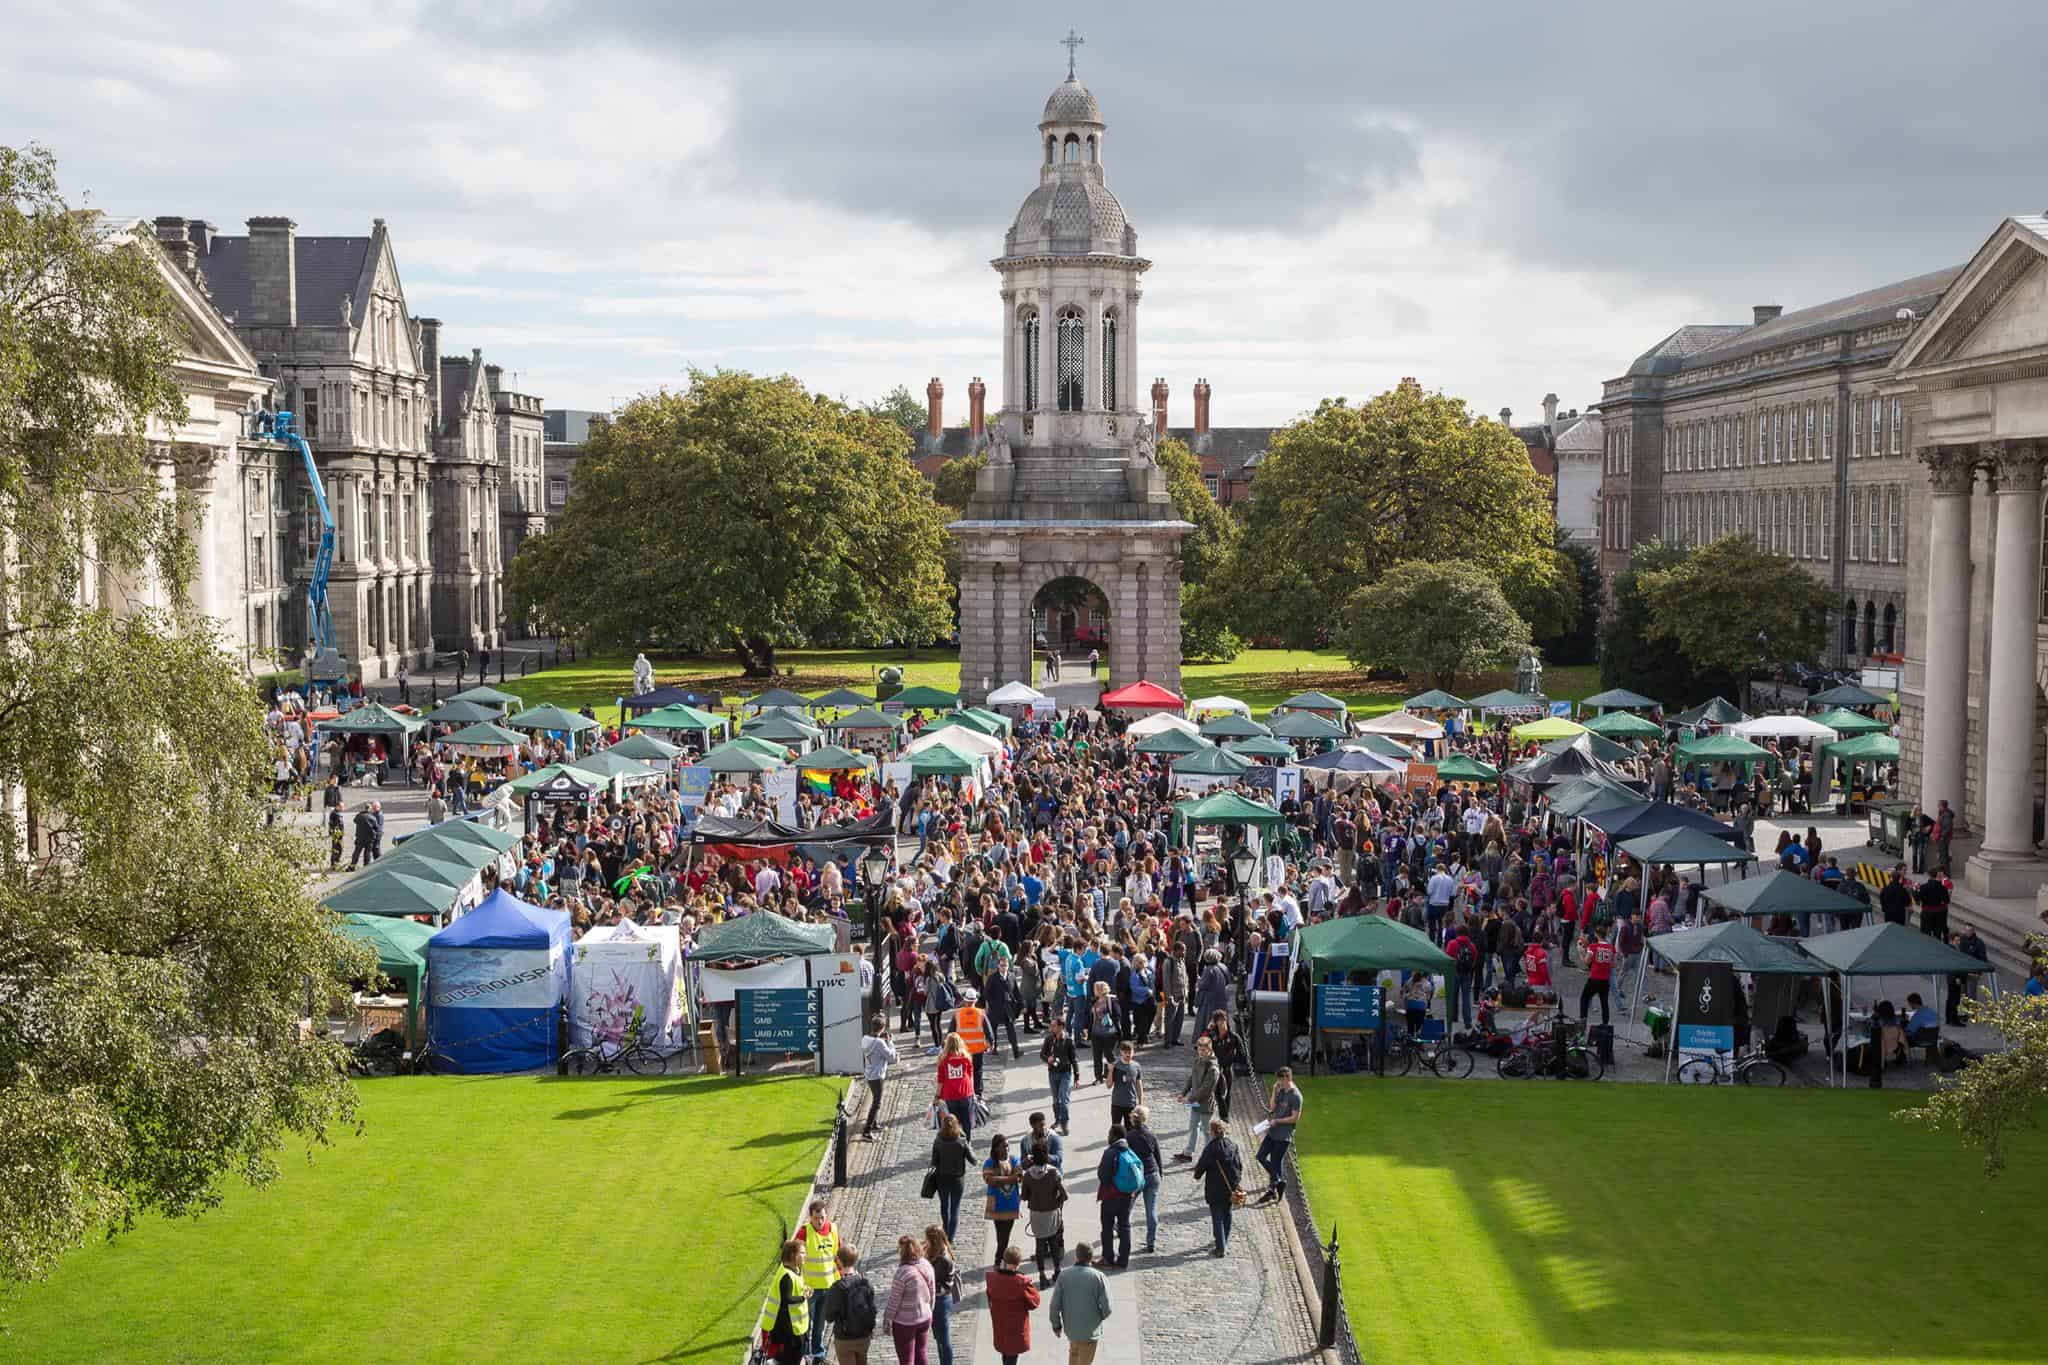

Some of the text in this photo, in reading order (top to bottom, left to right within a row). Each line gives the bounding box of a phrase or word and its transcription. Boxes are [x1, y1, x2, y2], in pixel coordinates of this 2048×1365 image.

[753, 1017, 773, 1025] GMB
[754, 1030, 772, 1038] UMB
[777, 1030, 794, 1038] ATM
